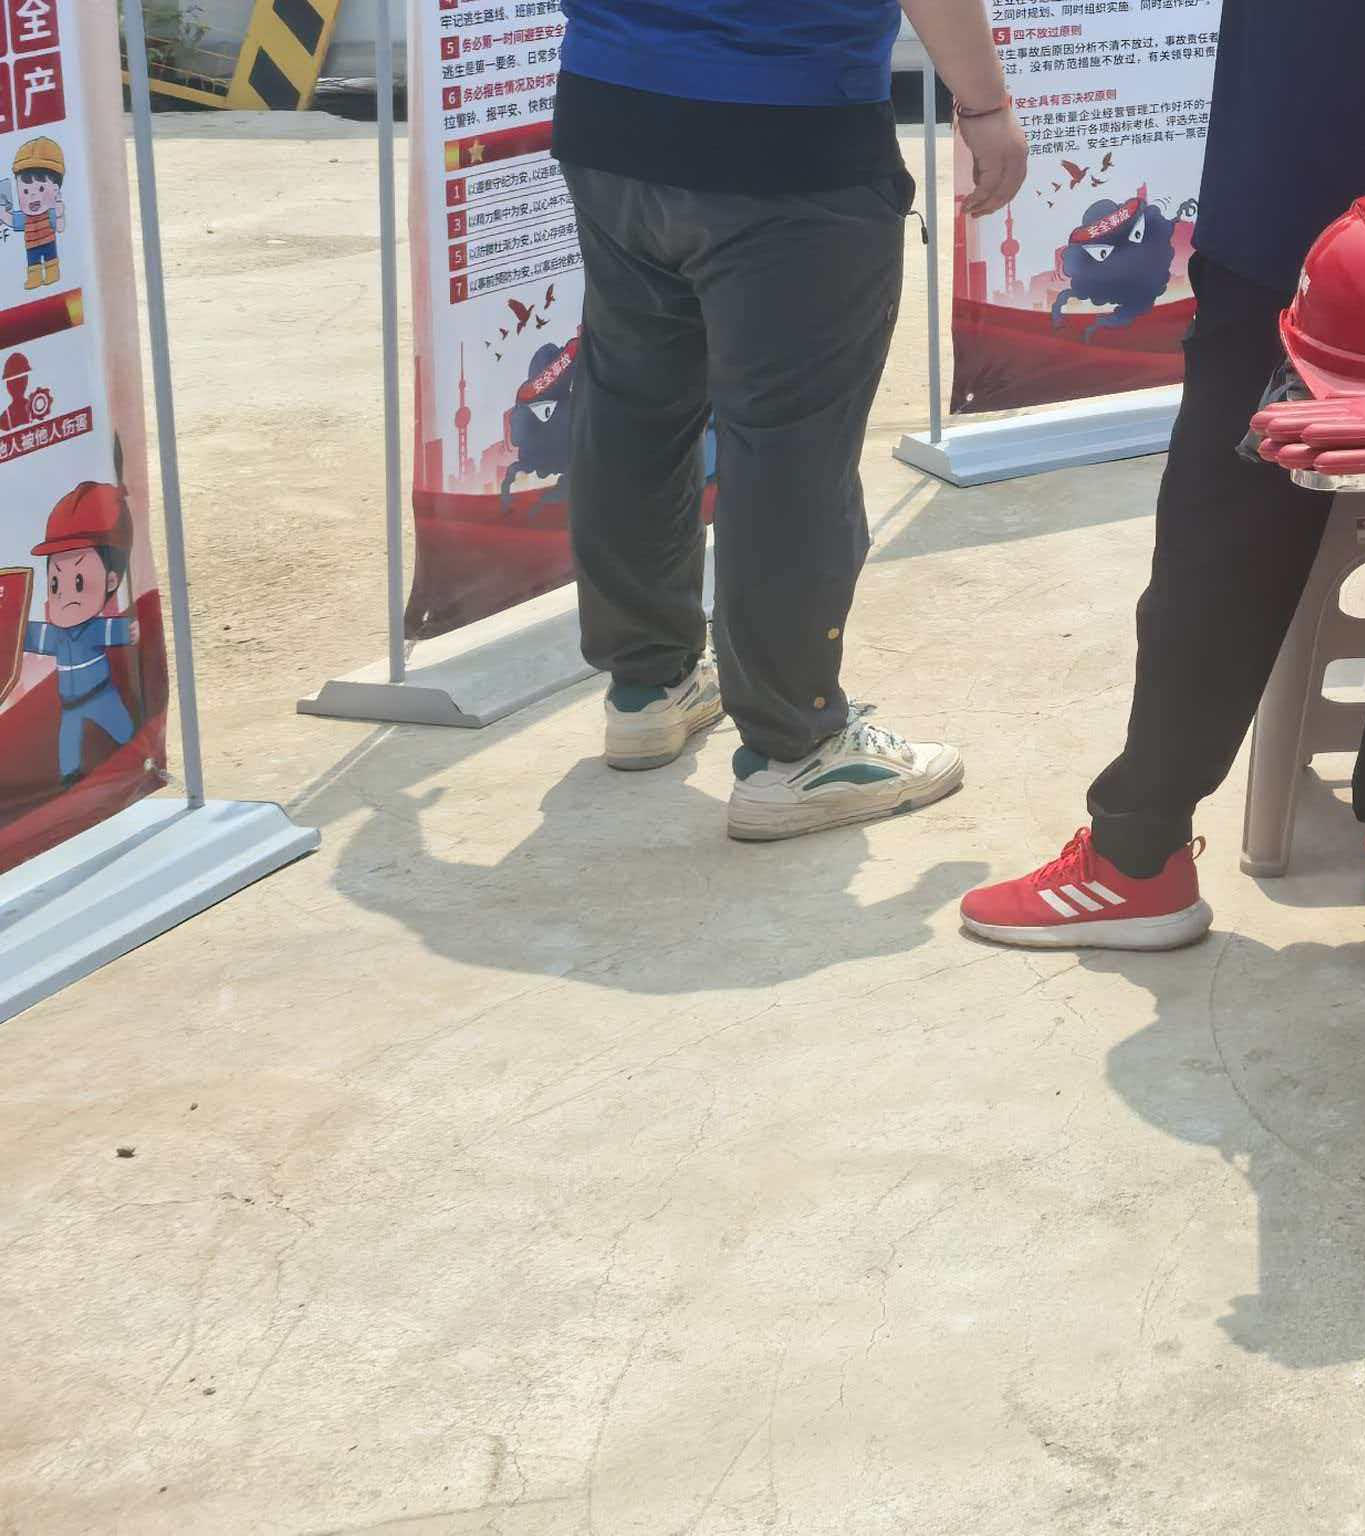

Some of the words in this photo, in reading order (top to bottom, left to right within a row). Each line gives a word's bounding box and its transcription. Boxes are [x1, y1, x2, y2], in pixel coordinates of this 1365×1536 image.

[1013, 24, 1083, 41] 四不放过原则
[442, 49, 562, 80] 逃生是第一要务、日常多
[463, 73, 560, 104] 务必报告情况及时求
[1015, 88, 1118, 110] 安全具有否决权原则
[1027, 125, 1207, 156] 完成情况。安全生产指标具有一票否
